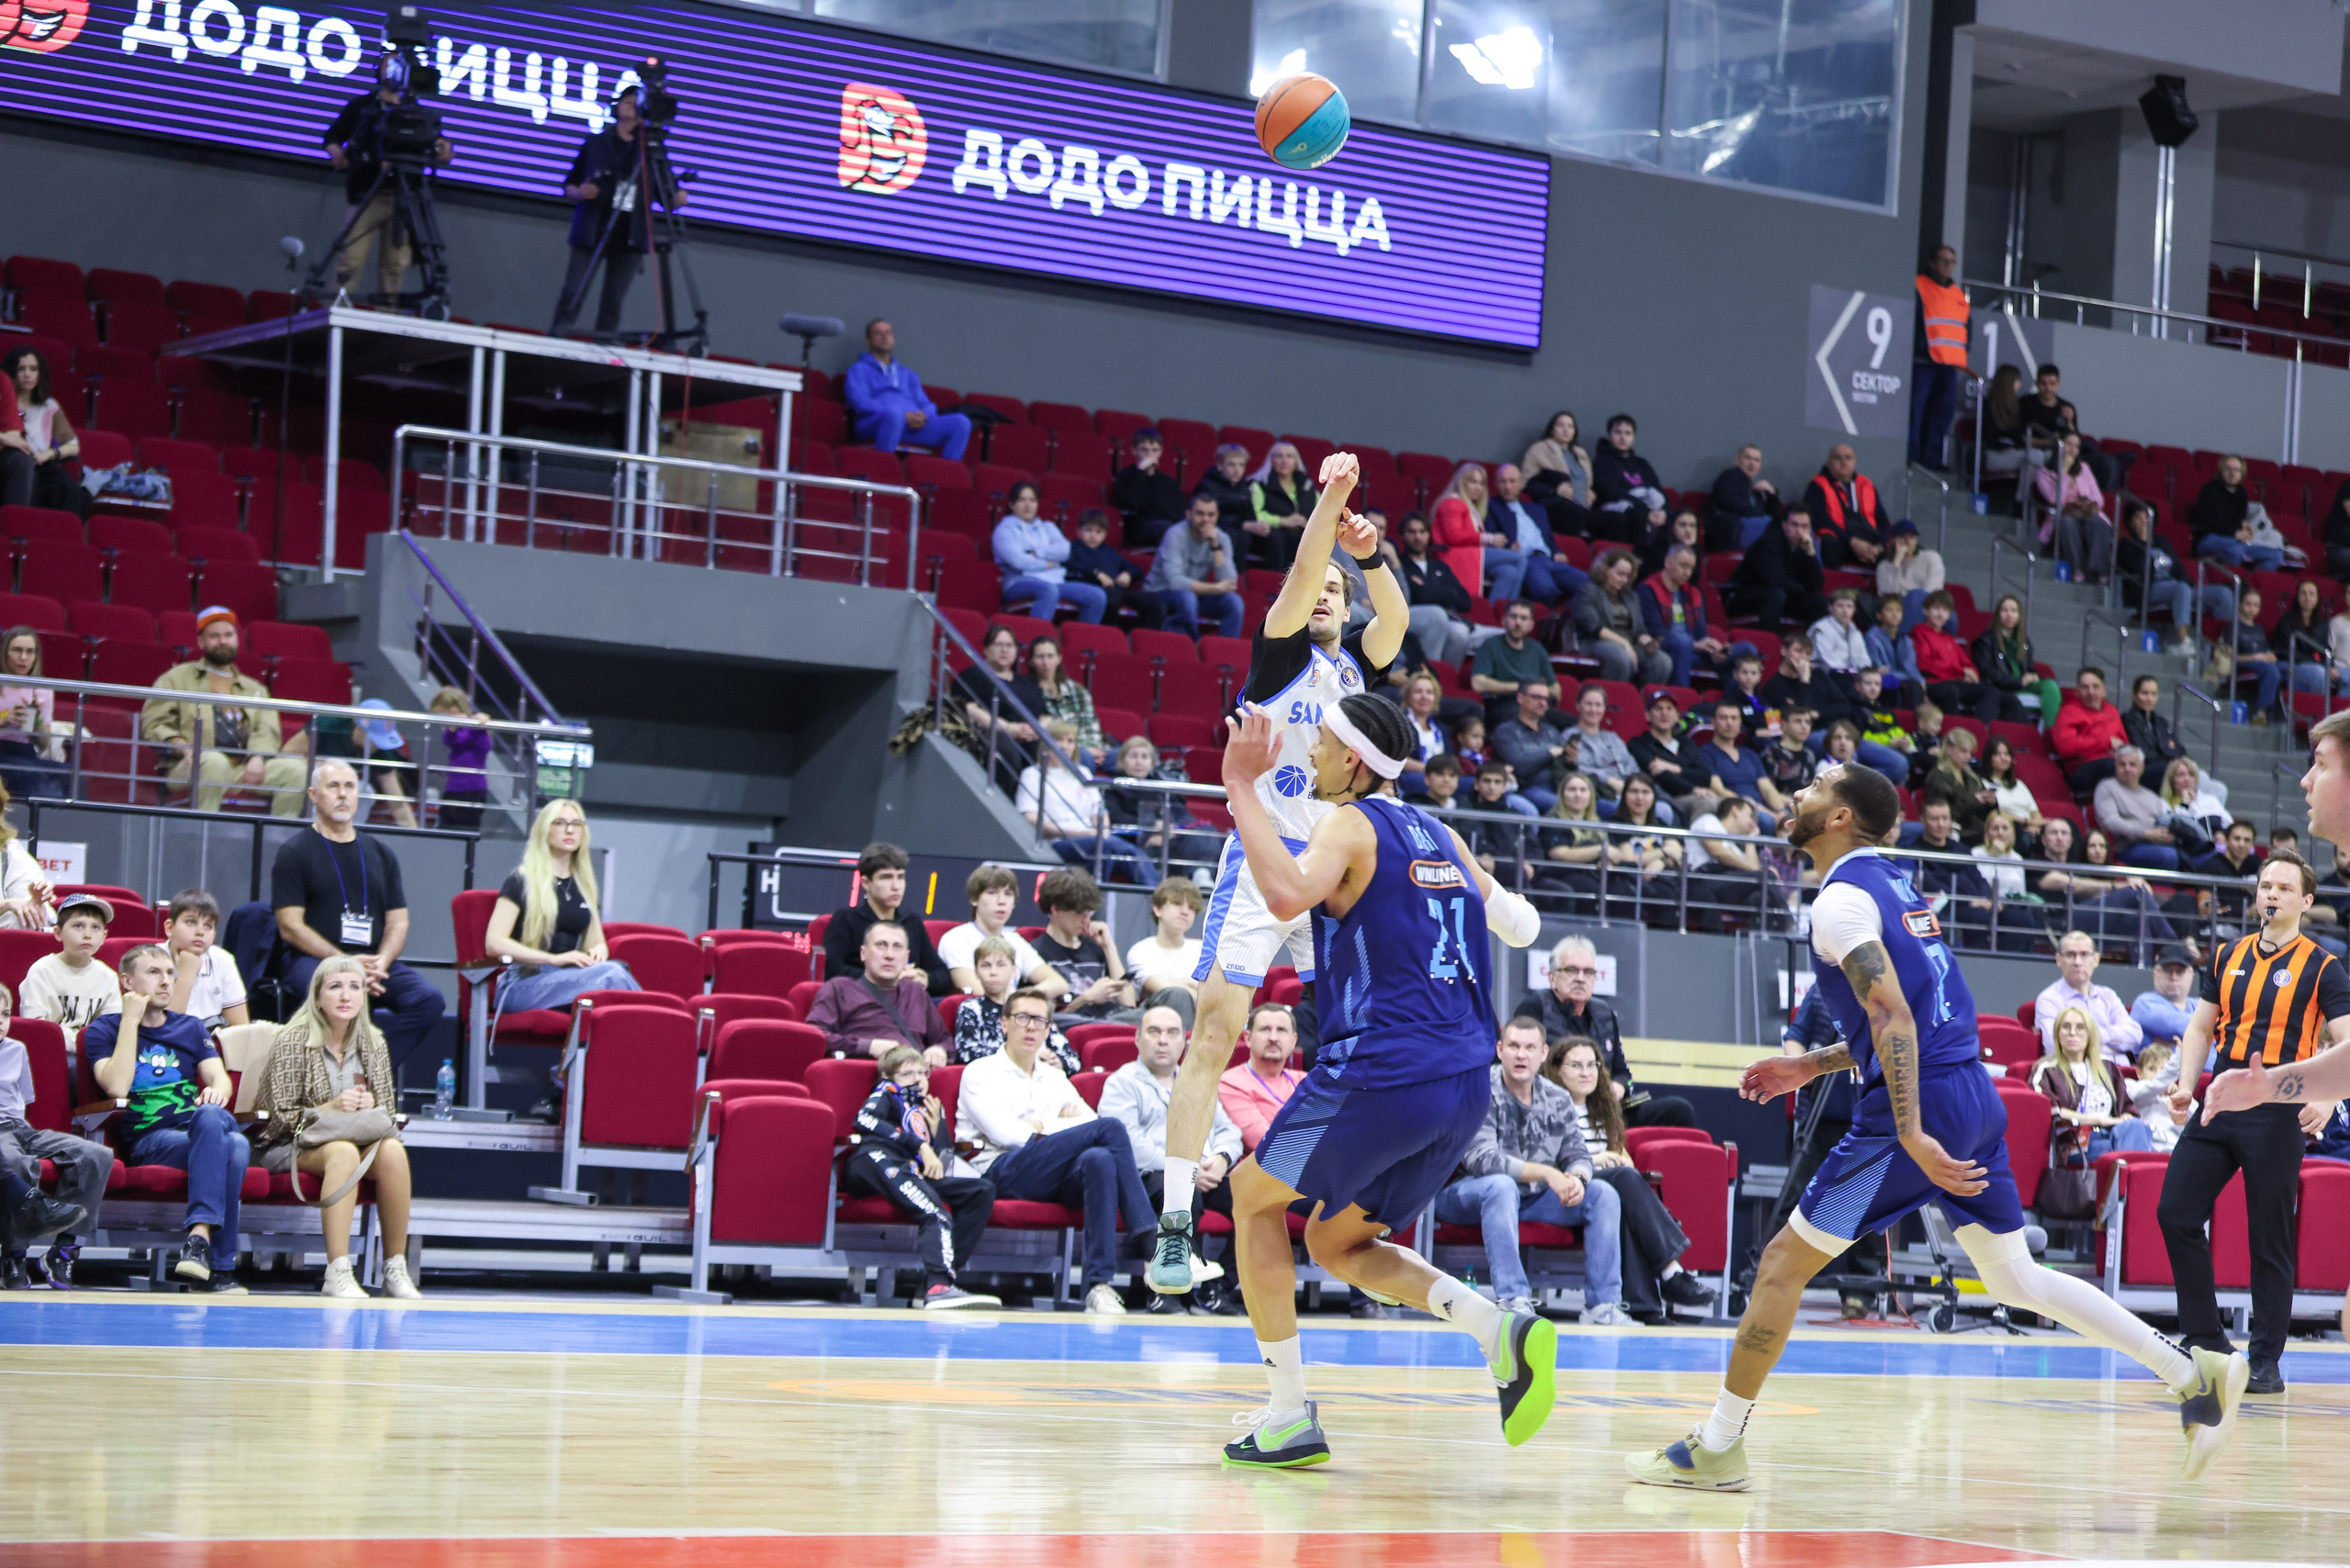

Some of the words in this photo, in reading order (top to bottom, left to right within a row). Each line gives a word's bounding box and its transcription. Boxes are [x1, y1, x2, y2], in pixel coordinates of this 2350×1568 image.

[952, 129, 1150, 216] ДОДО
[1162, 162, 1392, 256] ПИЦЦА
[1867, 307, 1893, 369] 9
[1983, 320, 1998, 379] 1
[1852, 371, 1901, 395] СЕКТОР
[1427, 897, 1477, 983] 21
